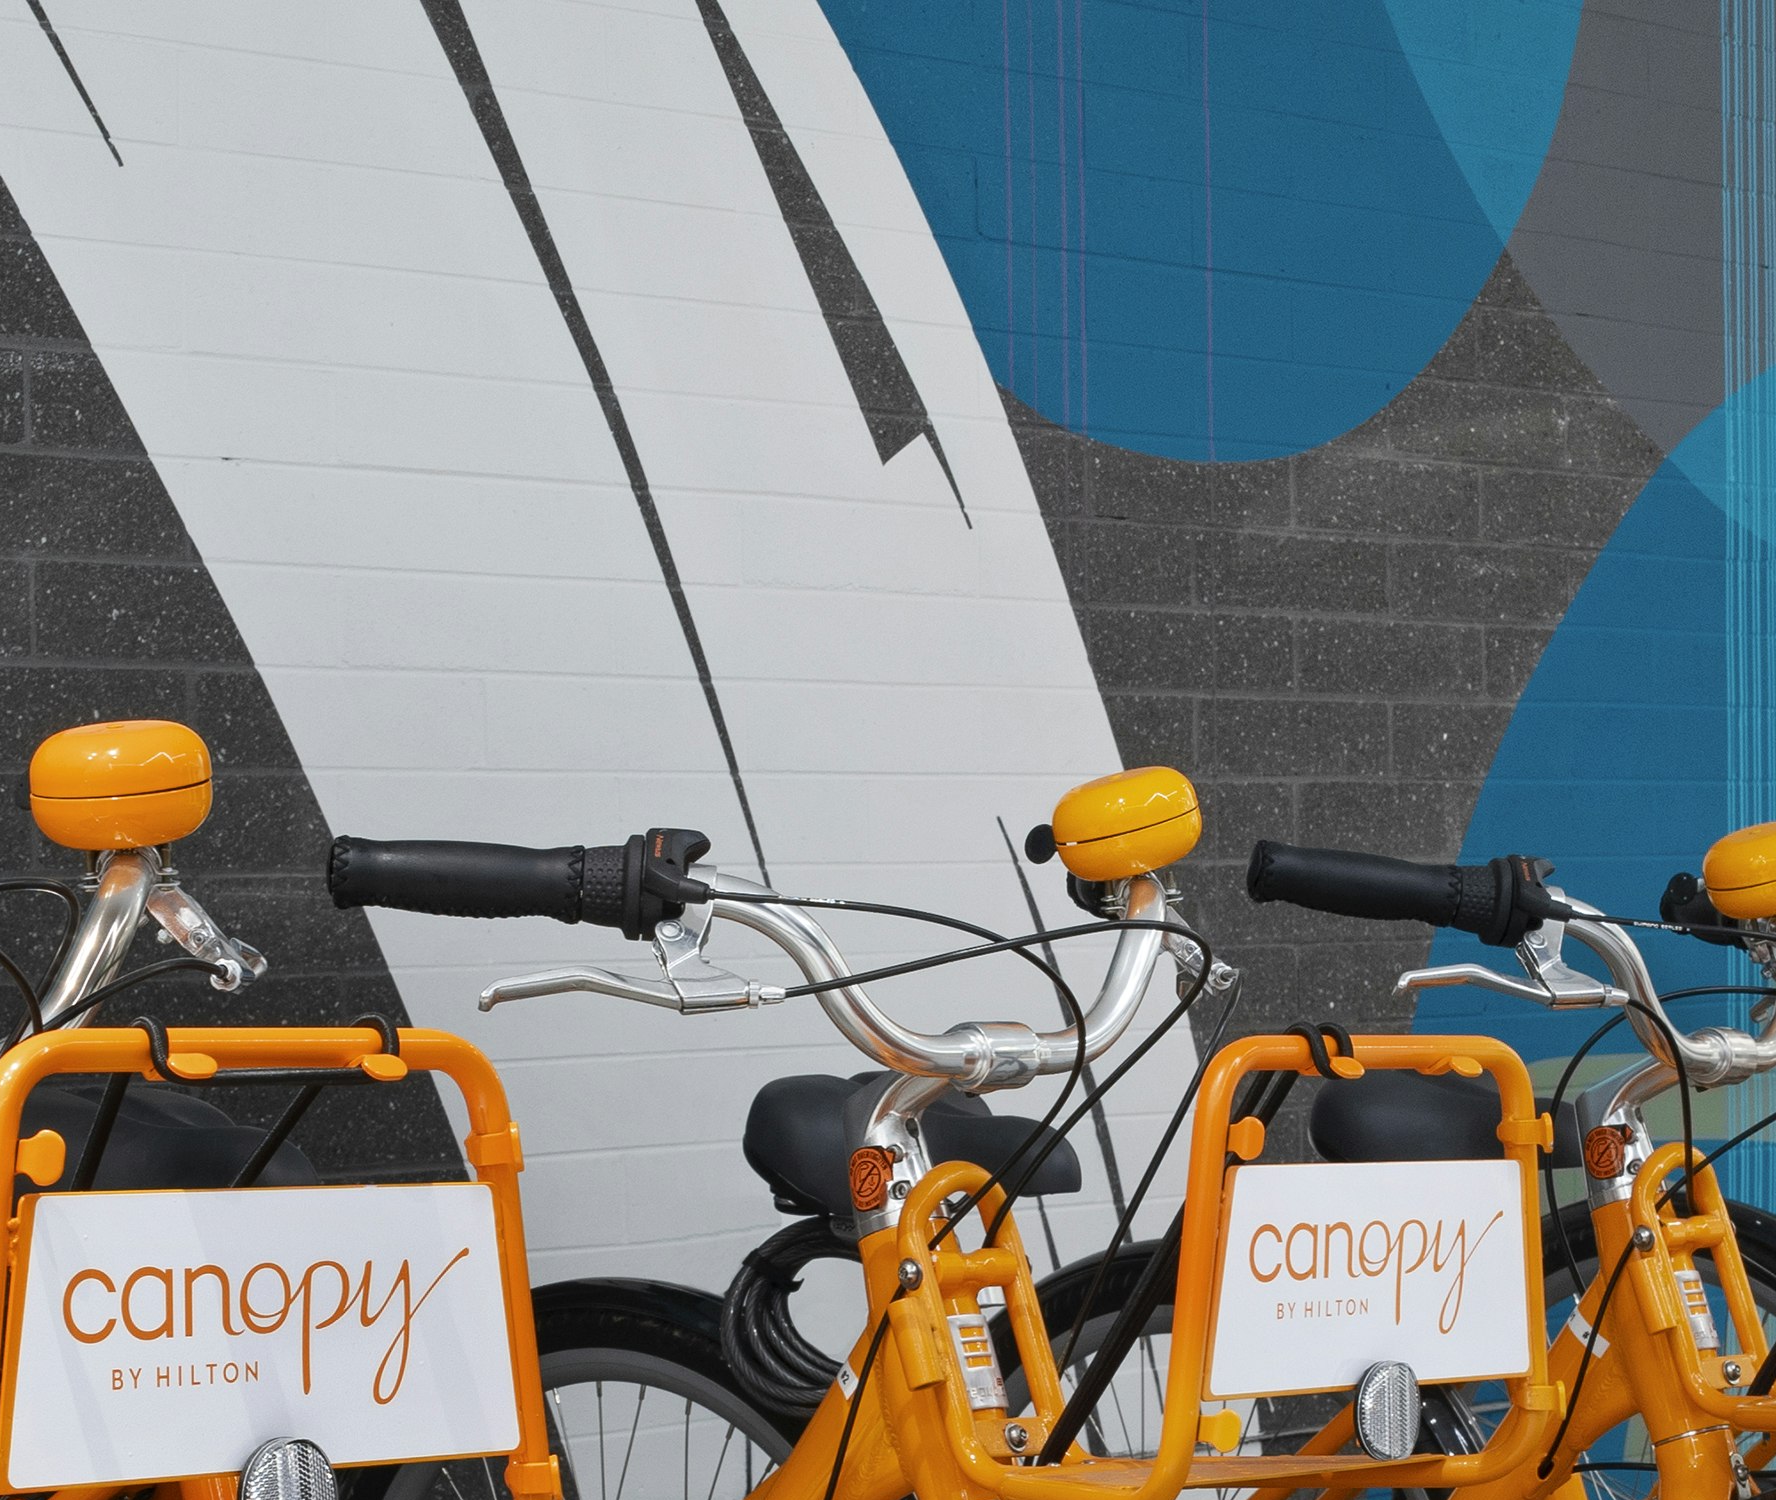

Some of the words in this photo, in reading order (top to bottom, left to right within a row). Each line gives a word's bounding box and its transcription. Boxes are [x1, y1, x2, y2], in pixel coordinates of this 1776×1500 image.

[1249, 1211, 1503, 1334] canopy
[1277, 1302, 1295, 1319] BY
[1305, 1299, 1368, 1317] HILTON
[63, 1247, 469, 1405] canopy
[112, 1368, 142, 1390] BY
[157, 1361, 258, 1387] HILTON
